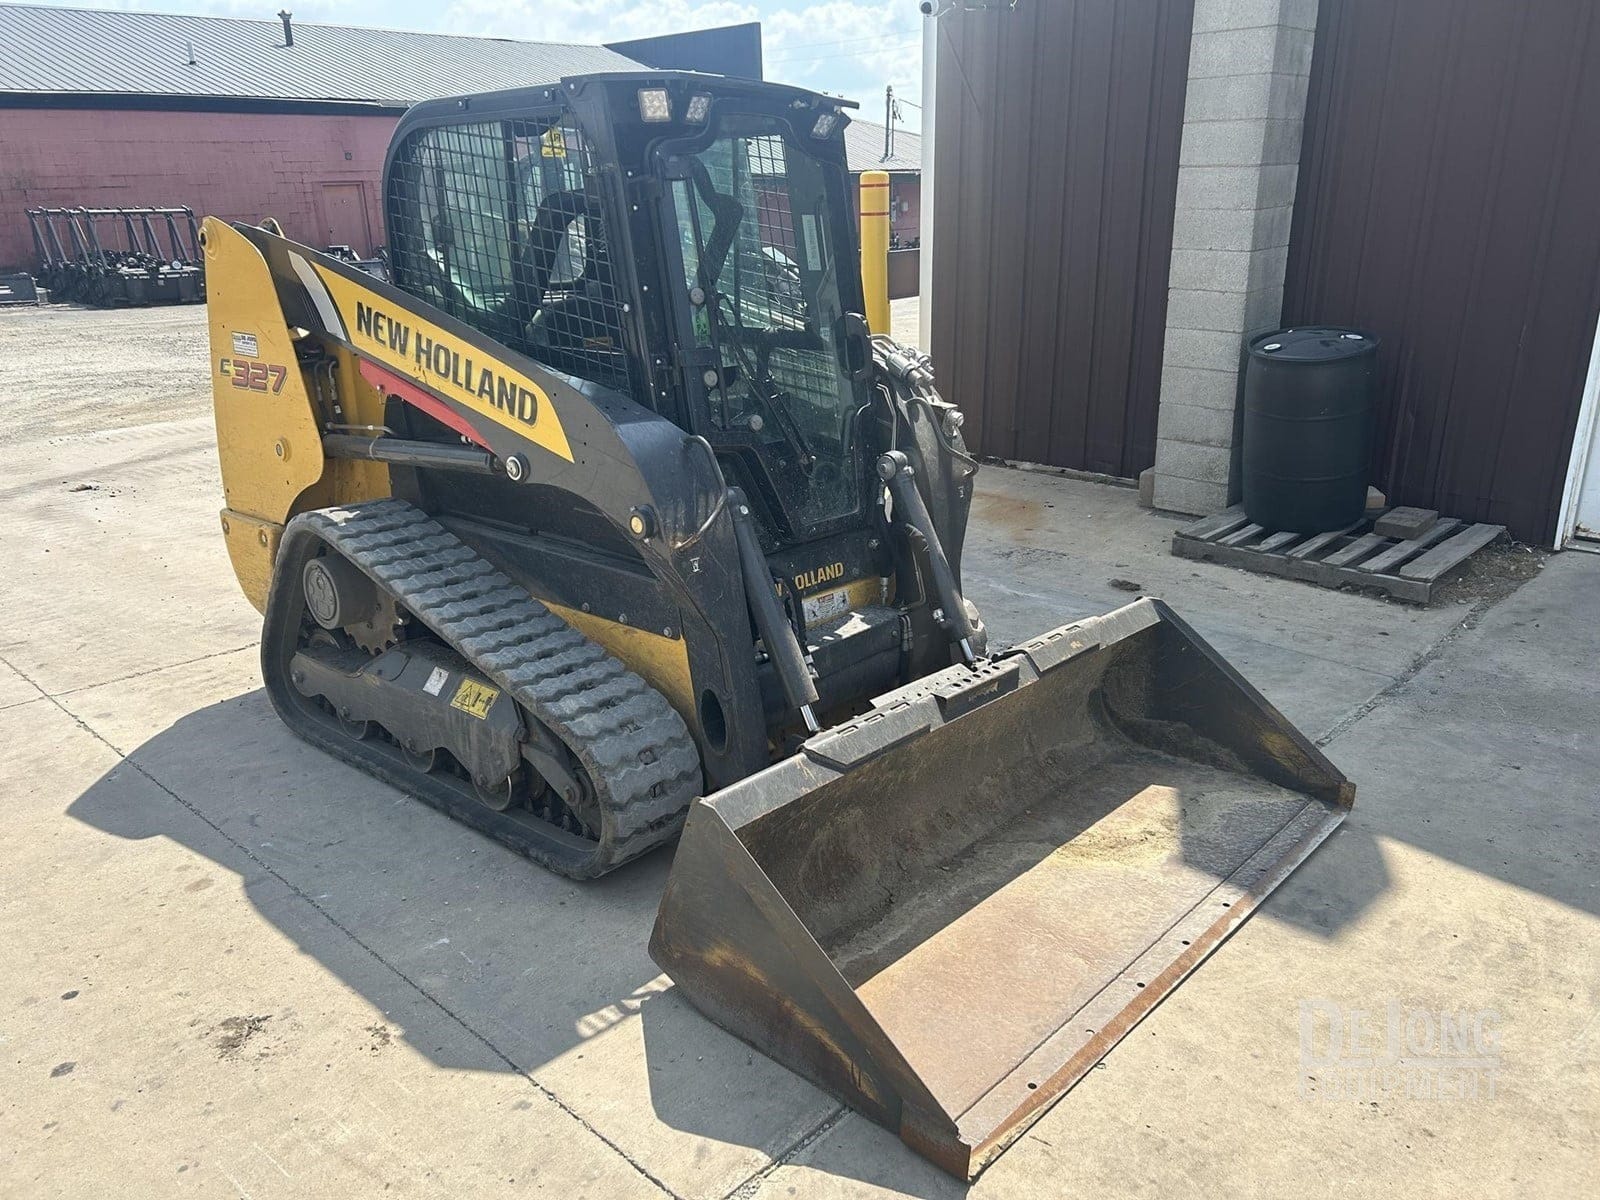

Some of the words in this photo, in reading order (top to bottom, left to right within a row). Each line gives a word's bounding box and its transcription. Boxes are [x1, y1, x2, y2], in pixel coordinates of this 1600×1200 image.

[357, 301, 409, 356] NEW
[415, 331, 538, 427] HOLLAND
[794, 562, 844, 590] OLLAND
